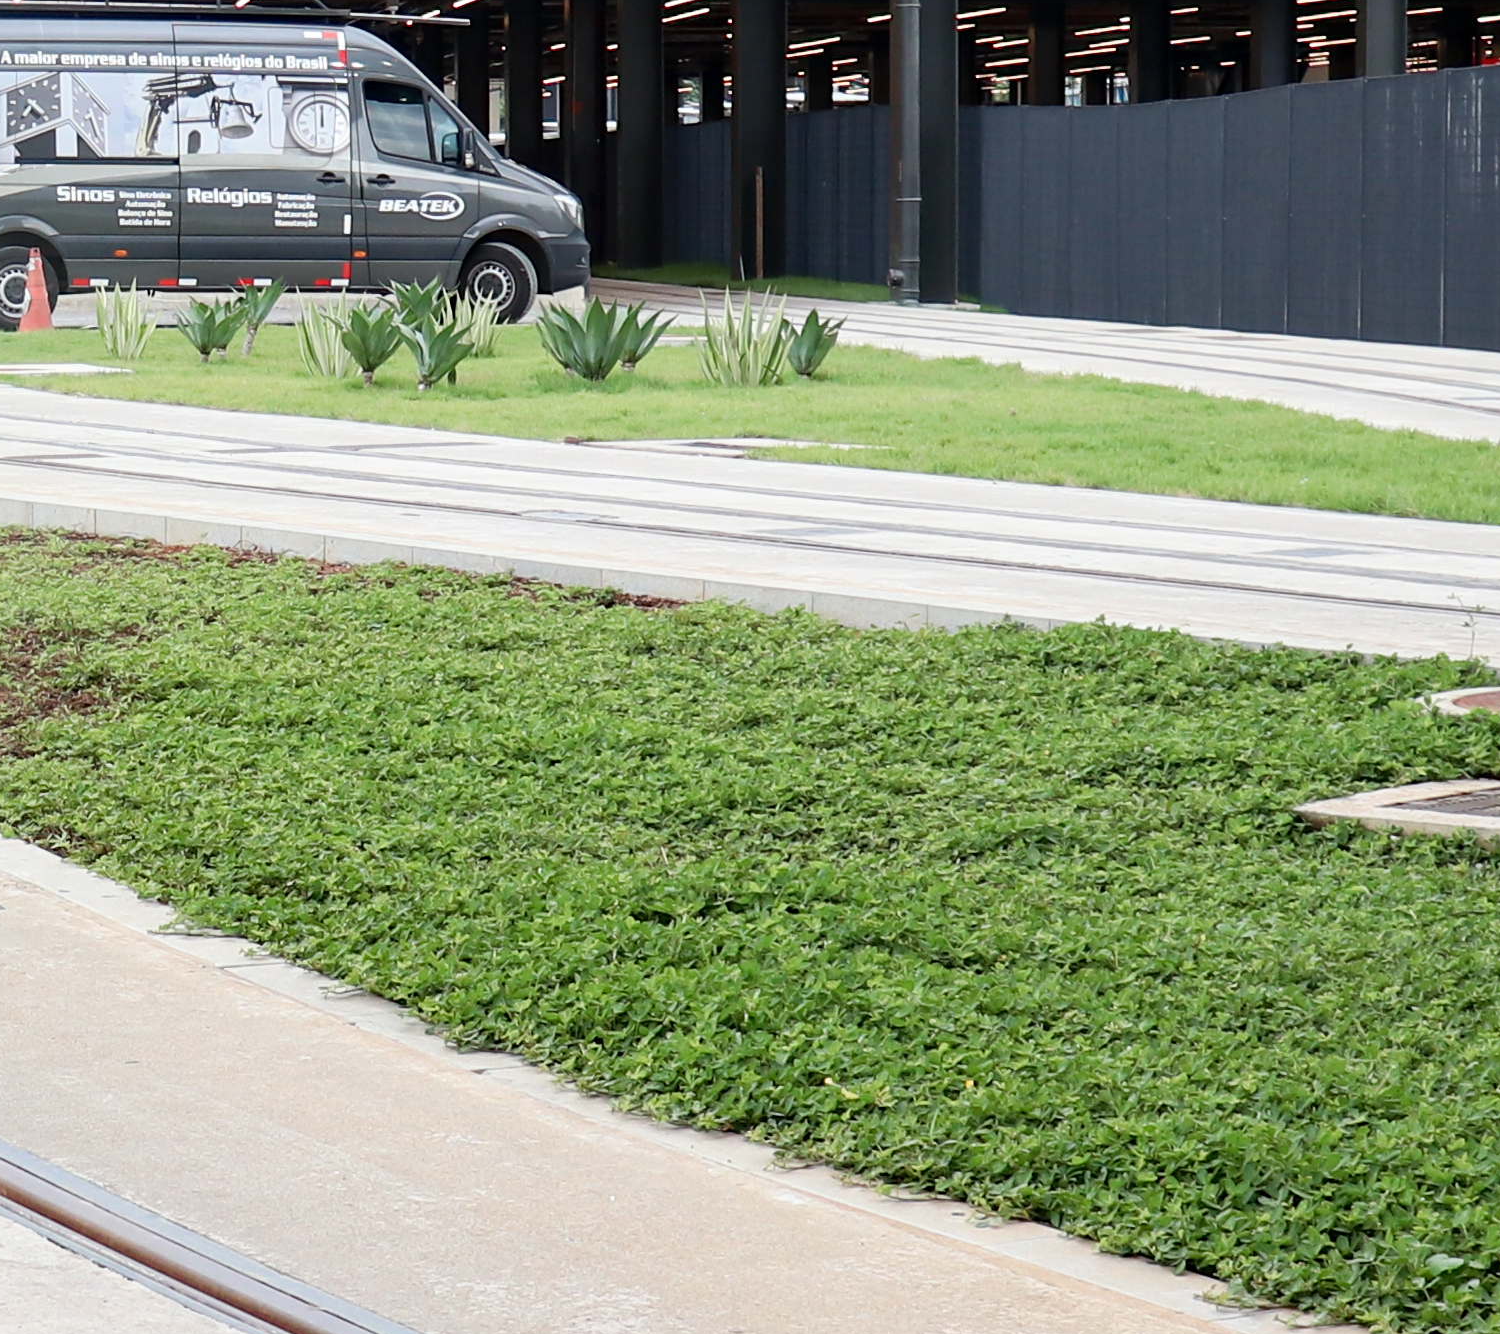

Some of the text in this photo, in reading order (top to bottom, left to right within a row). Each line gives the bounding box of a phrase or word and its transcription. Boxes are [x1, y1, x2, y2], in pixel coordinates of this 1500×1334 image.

[0, 50, 12, 64] A
[14, 50, 58, 65] maior
[60, 53, 126, 69] empresa
[128, 52, 147, 66] de
[151, 53, 190, 67] sinos
[192, 55, 202, 66] e
[203, 53, 262, 70] relógios
[267, 54, 284, 68] do
[285, 55, 328, 69] Brasil
[56, 186, 115, 202] Sinos
[186, 186, 273, 208] Relógios
[378, 199, 456, 213] BEATEK
